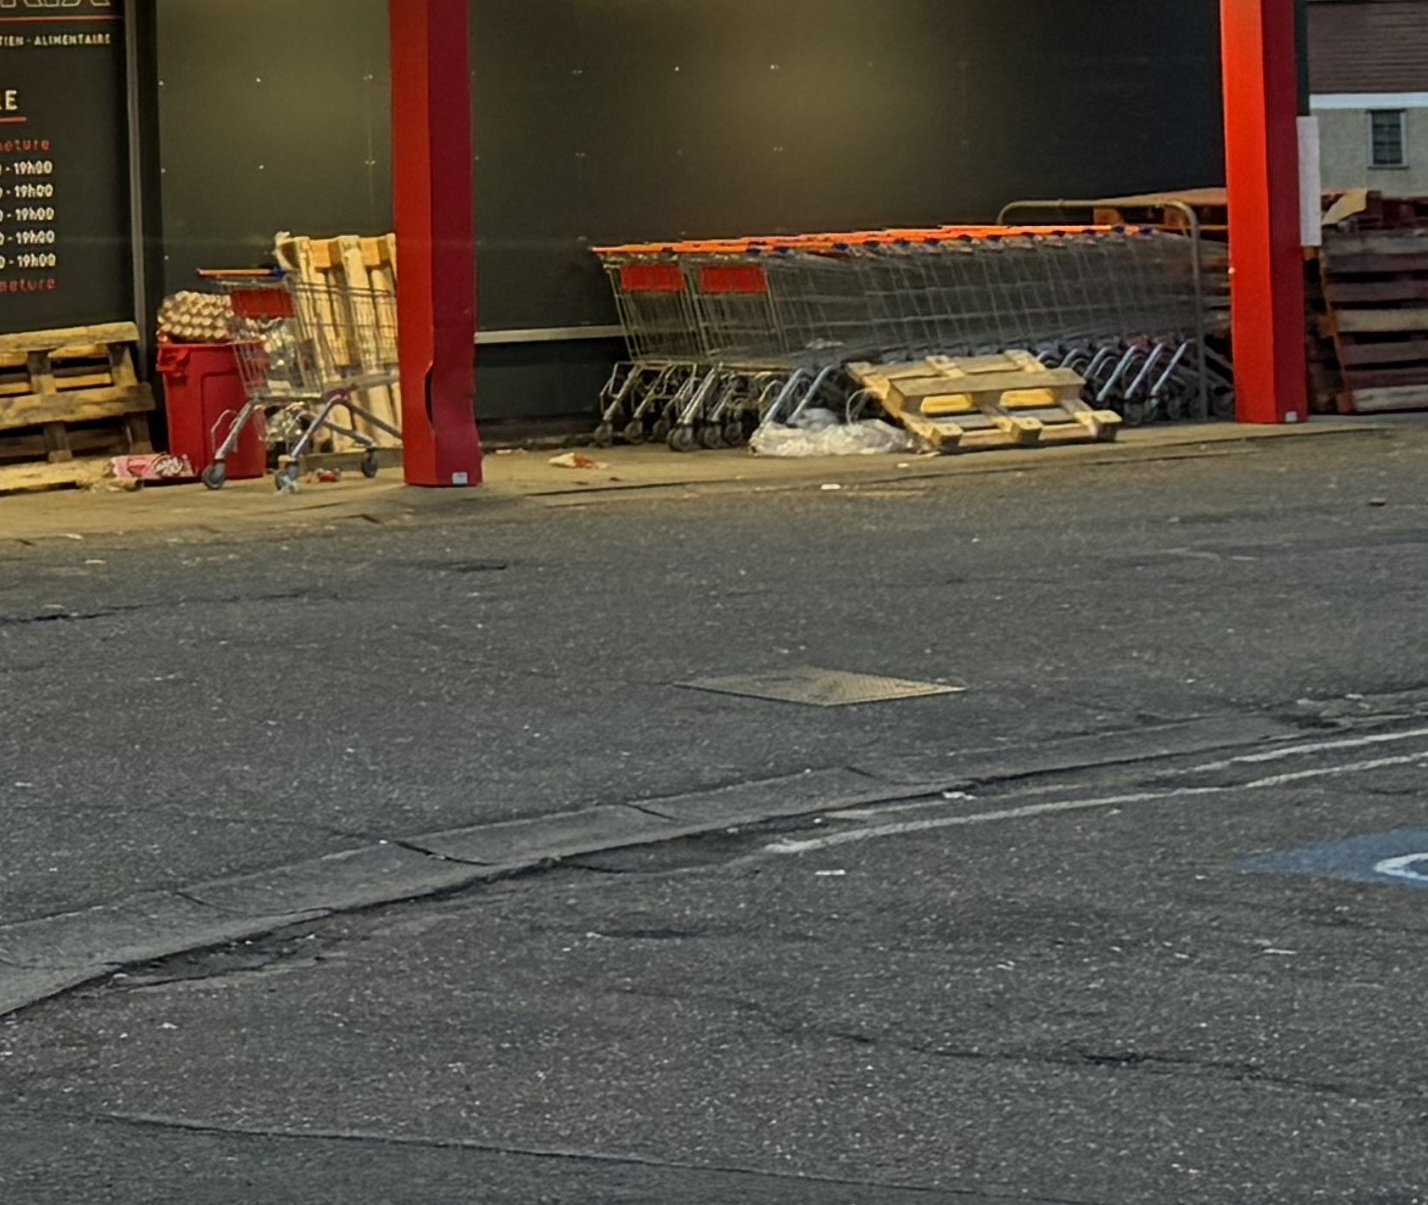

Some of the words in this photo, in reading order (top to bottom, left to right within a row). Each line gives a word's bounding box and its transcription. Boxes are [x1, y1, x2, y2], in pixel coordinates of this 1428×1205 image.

[34, 33, 111, 46] ALIMENTAIRE
[13, 161, 53, 175] 19h00
[14, 184, 54, 198] 19h00
[15, 207, 55, 221] 19h00
[16, 230, 55, 244] 19h00
[17, 253, 56, 268] 19h00
